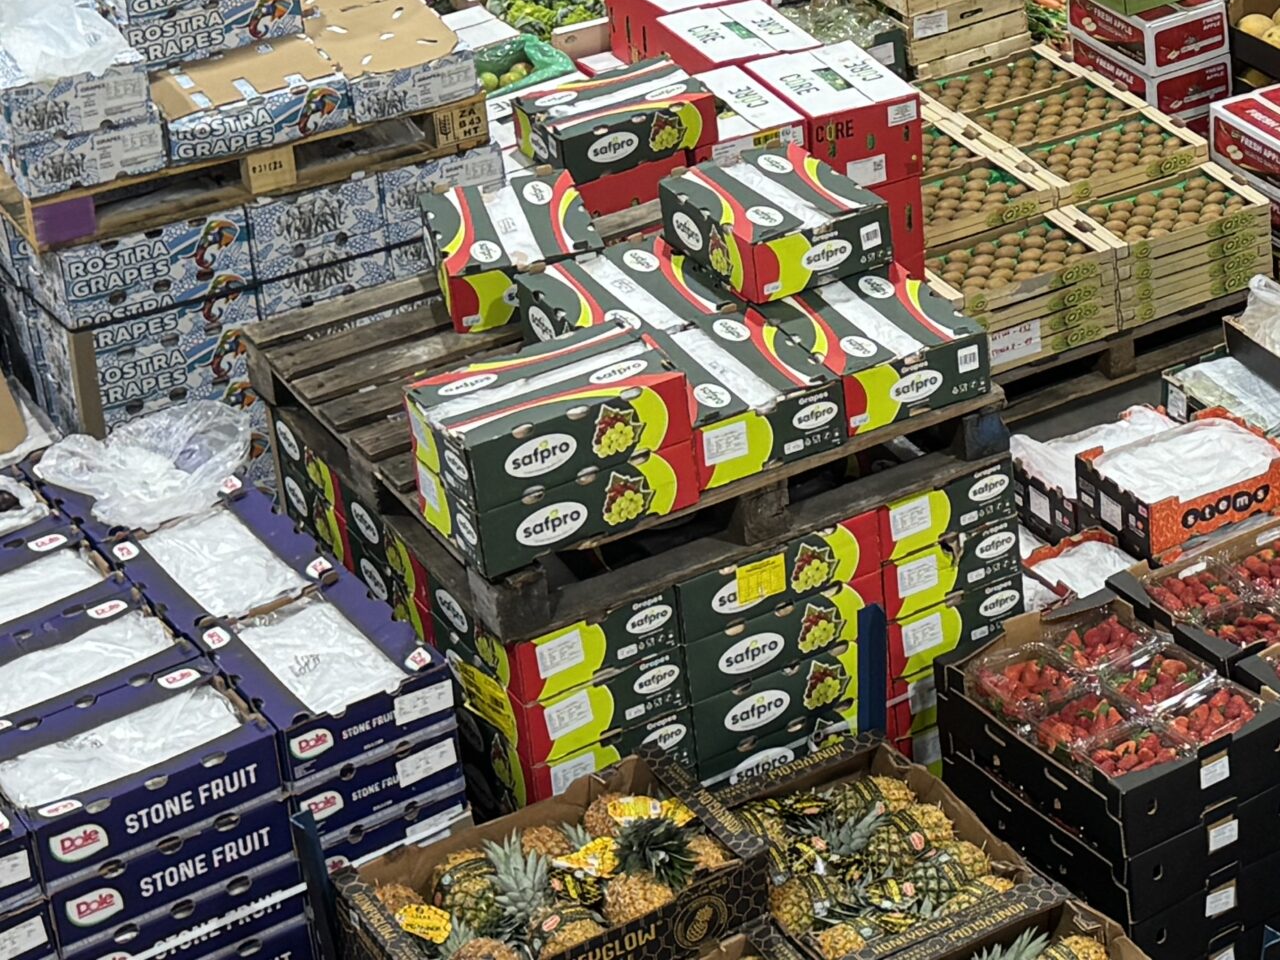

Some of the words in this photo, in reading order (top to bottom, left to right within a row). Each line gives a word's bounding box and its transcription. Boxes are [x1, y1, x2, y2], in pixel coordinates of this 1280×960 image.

[128, 12, 224, 46] ROSTRA
[1093, 7, 1112, 26] FRESH
[1113, 17, 1133, 36] APPLE
[179, 110, 271, 141] ROSTRA
[459, 109, 476, 119] ZA
[469, 116, 482, 127] 43
[1245, 108, 1276, 129] FRESH
[463, 127, 480, 137] HT
[1240, 128, 1263, 152] FRESH
[176, 130, 275, 161] GRAPES
[592, 137, 634, 155] safpro
[69, 240, 169, 279] ROSTRA
[806, 244, 848, 265] safpro
[72, 259, 170, 299] GRAPES
[798, 391, 828, 405] Grapes
[894, 375, 938, 396] safpro
[797, 405, 834, 425] safpro
[510, 439, 572, 470] safpro
[972, 479, 1006, 496] safpro
[1180, 485, 1271, 528] stems
[522, 506, 583, 539] safpro
[632, 595, 663, 610] Grapes
[631, 610, 668, 629] safpro
[639, 655, 670, 671] Grapes
[725, 640, 778, 667] safpro
[638, 669, 676, 689] safpro
[731, 698, 784, 725] safpro
[298, 732, 328, 754] Dole
[342, 721, 371, 740] STONE
[124, 792, 195, 834] STONE
[198, 763, 259, 807] FRUIT
[308, 795, 336, 814] Dole
[352, 782, 380, 801] STONE
[60, 828, 100, 853] Dole
[139, 856, 209, 898] STONE
[212, 826, 272, 870] FRUIT
[76, 892, 118, 917] Dole
